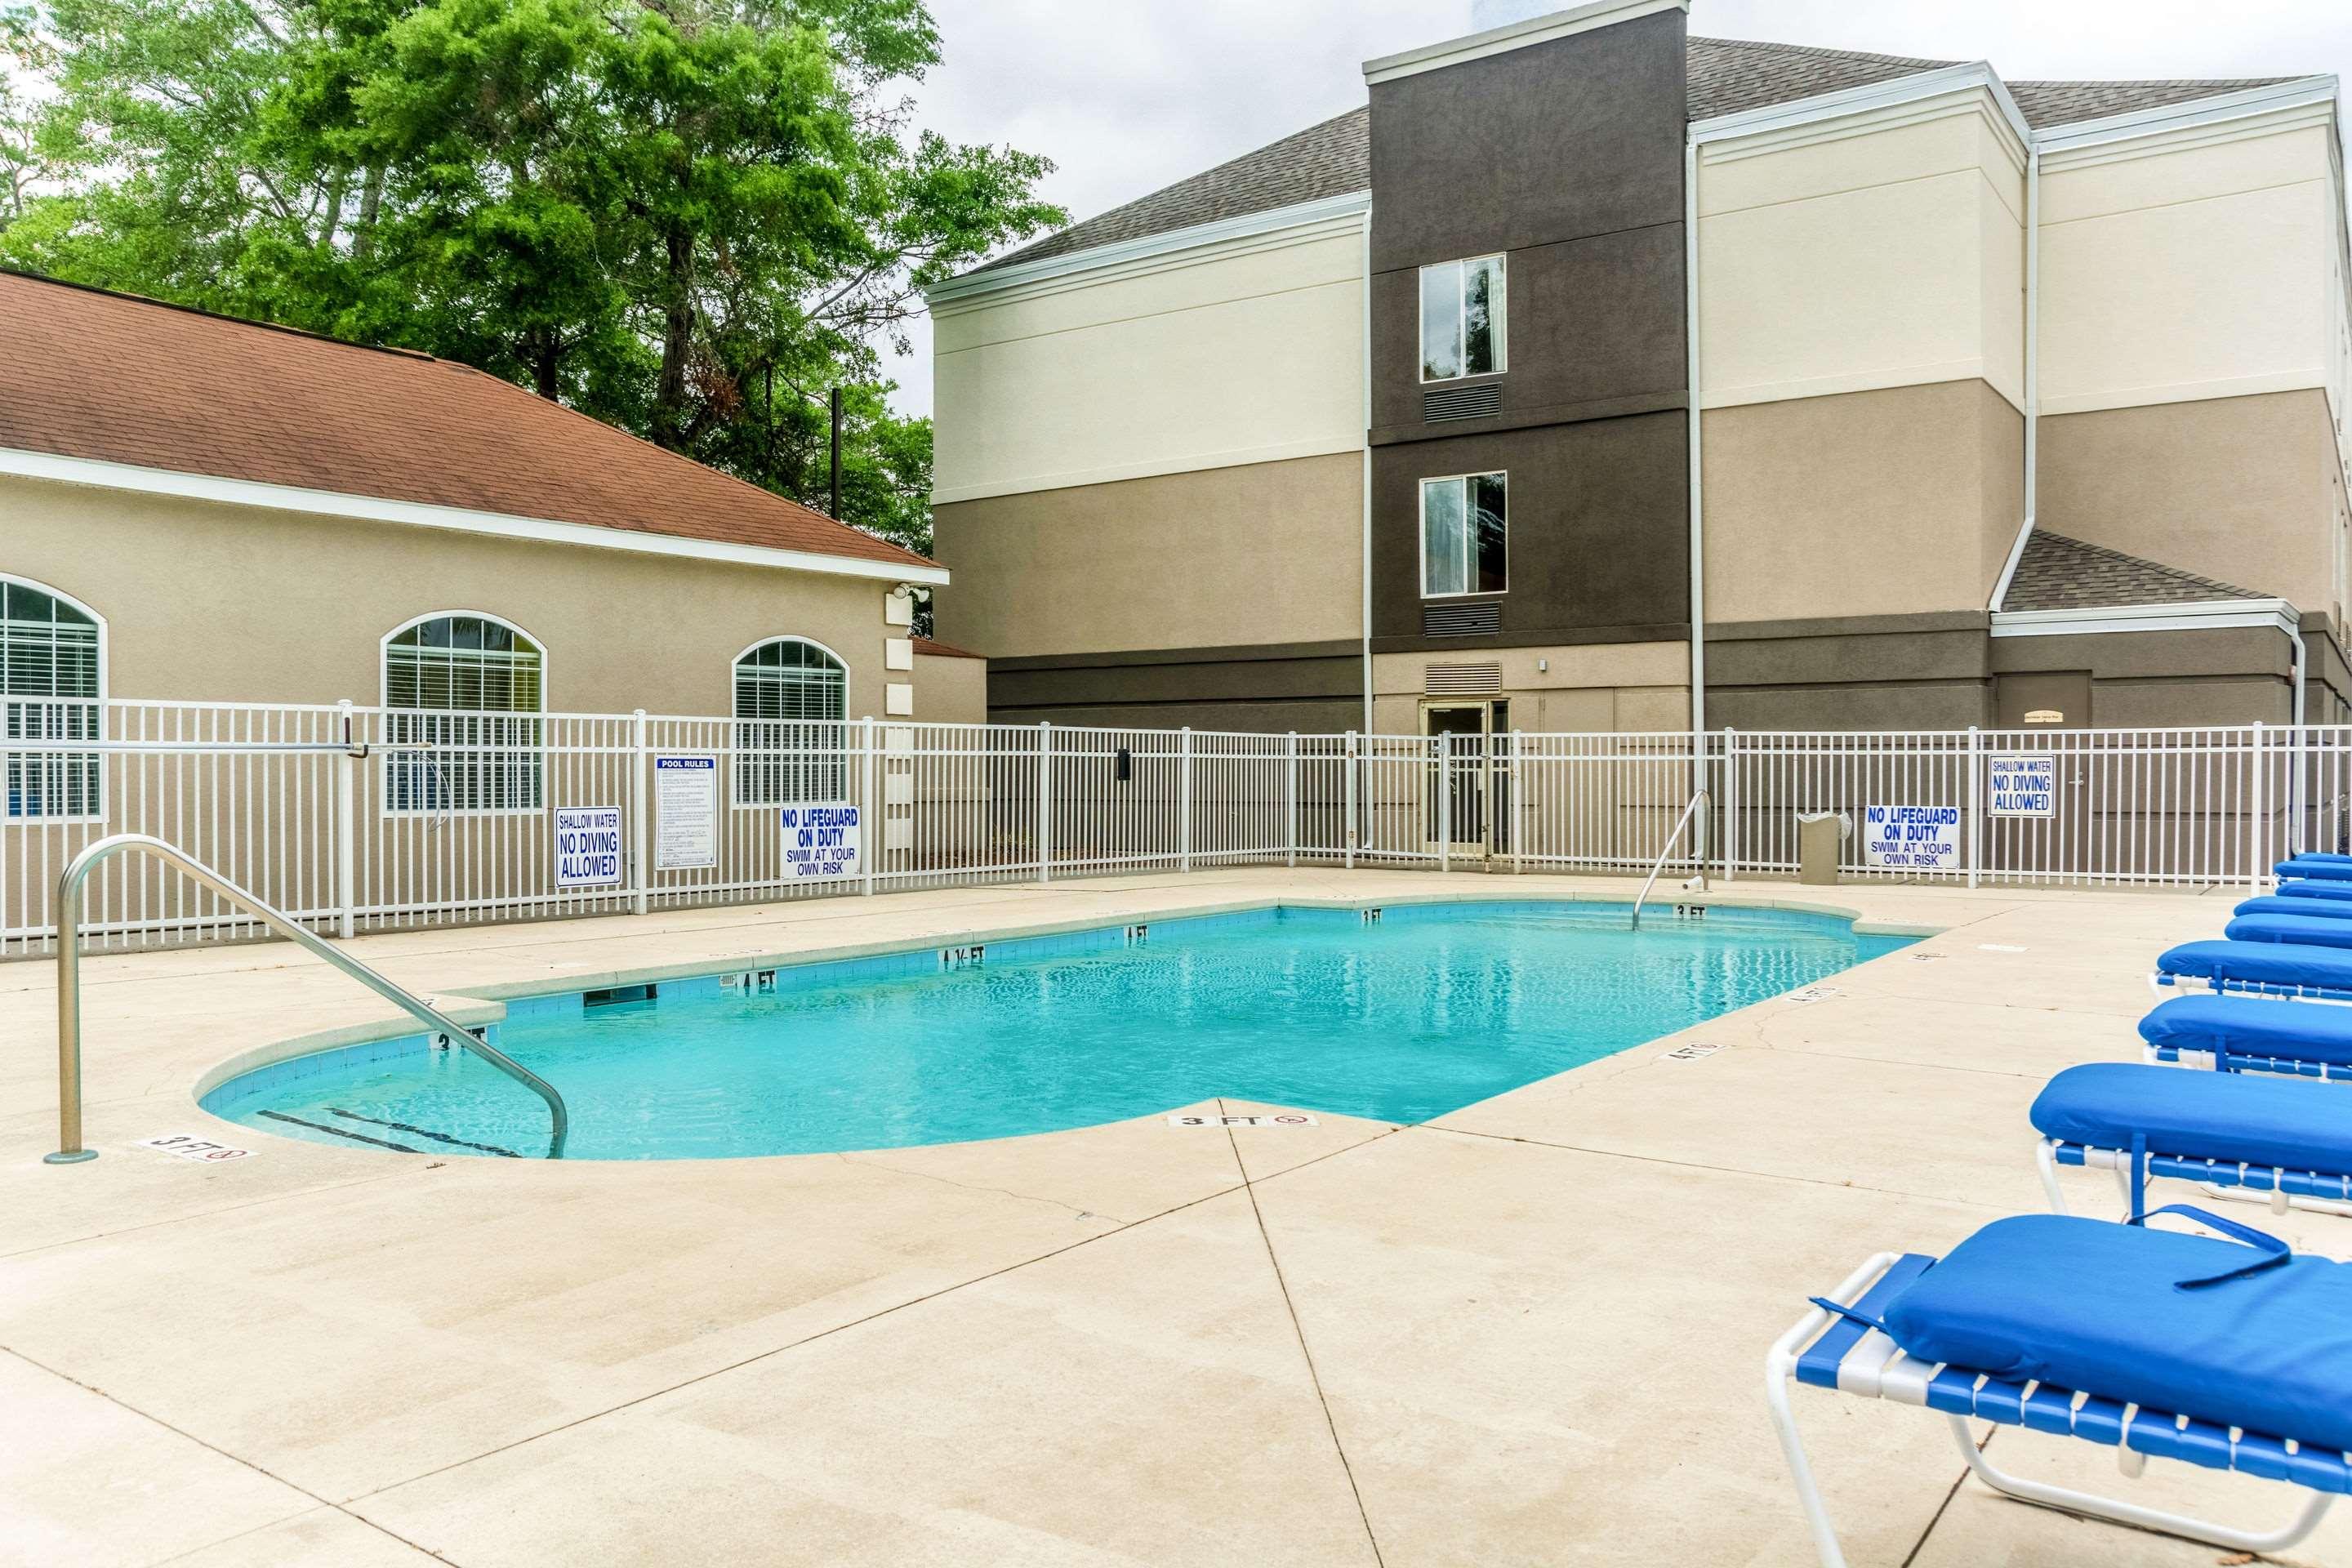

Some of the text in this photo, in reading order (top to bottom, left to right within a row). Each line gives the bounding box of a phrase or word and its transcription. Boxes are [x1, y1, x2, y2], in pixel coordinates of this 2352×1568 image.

[1993, 760, 2051, 772] SHALLOW WATER
[1993, 775, 2051, 791] NO DIVING
[1994, 793, 2049, 810] ALLOWED
[559, 813, 617, 829] SHALLOW WATER
[782, 808, 858, 828] NO LIFEGUARD
[1868, 807, 1958, 825] NO LIFEGUARD
[798, 828, 844, 848] ON DUTY
[1884, 824, 1939, 841] ON DUTY
[560, 831, 617, 854] NO DIVING
[1871, 841, 1953, 854] SWIM AT YOUR
[786, 848, 855, 862] SWIM AT YOUR
[1884, 853, 1939, 866] OWN RISK
[561, 855, 617, 879] ALLOWED
[797, 862, 843, 875] OWN RISK
[1372, 908, 1381, 919] FT
[1690, 906, 1705, 915] FT
[1136, 925, 1147, 938] FT
[971, 947, 984, 960] FT
[757, 970, 775, 986] FT
[1182, 1116, 1262, 1125] 3 FT
[150, 1137, 225, 1153] 3 FT
